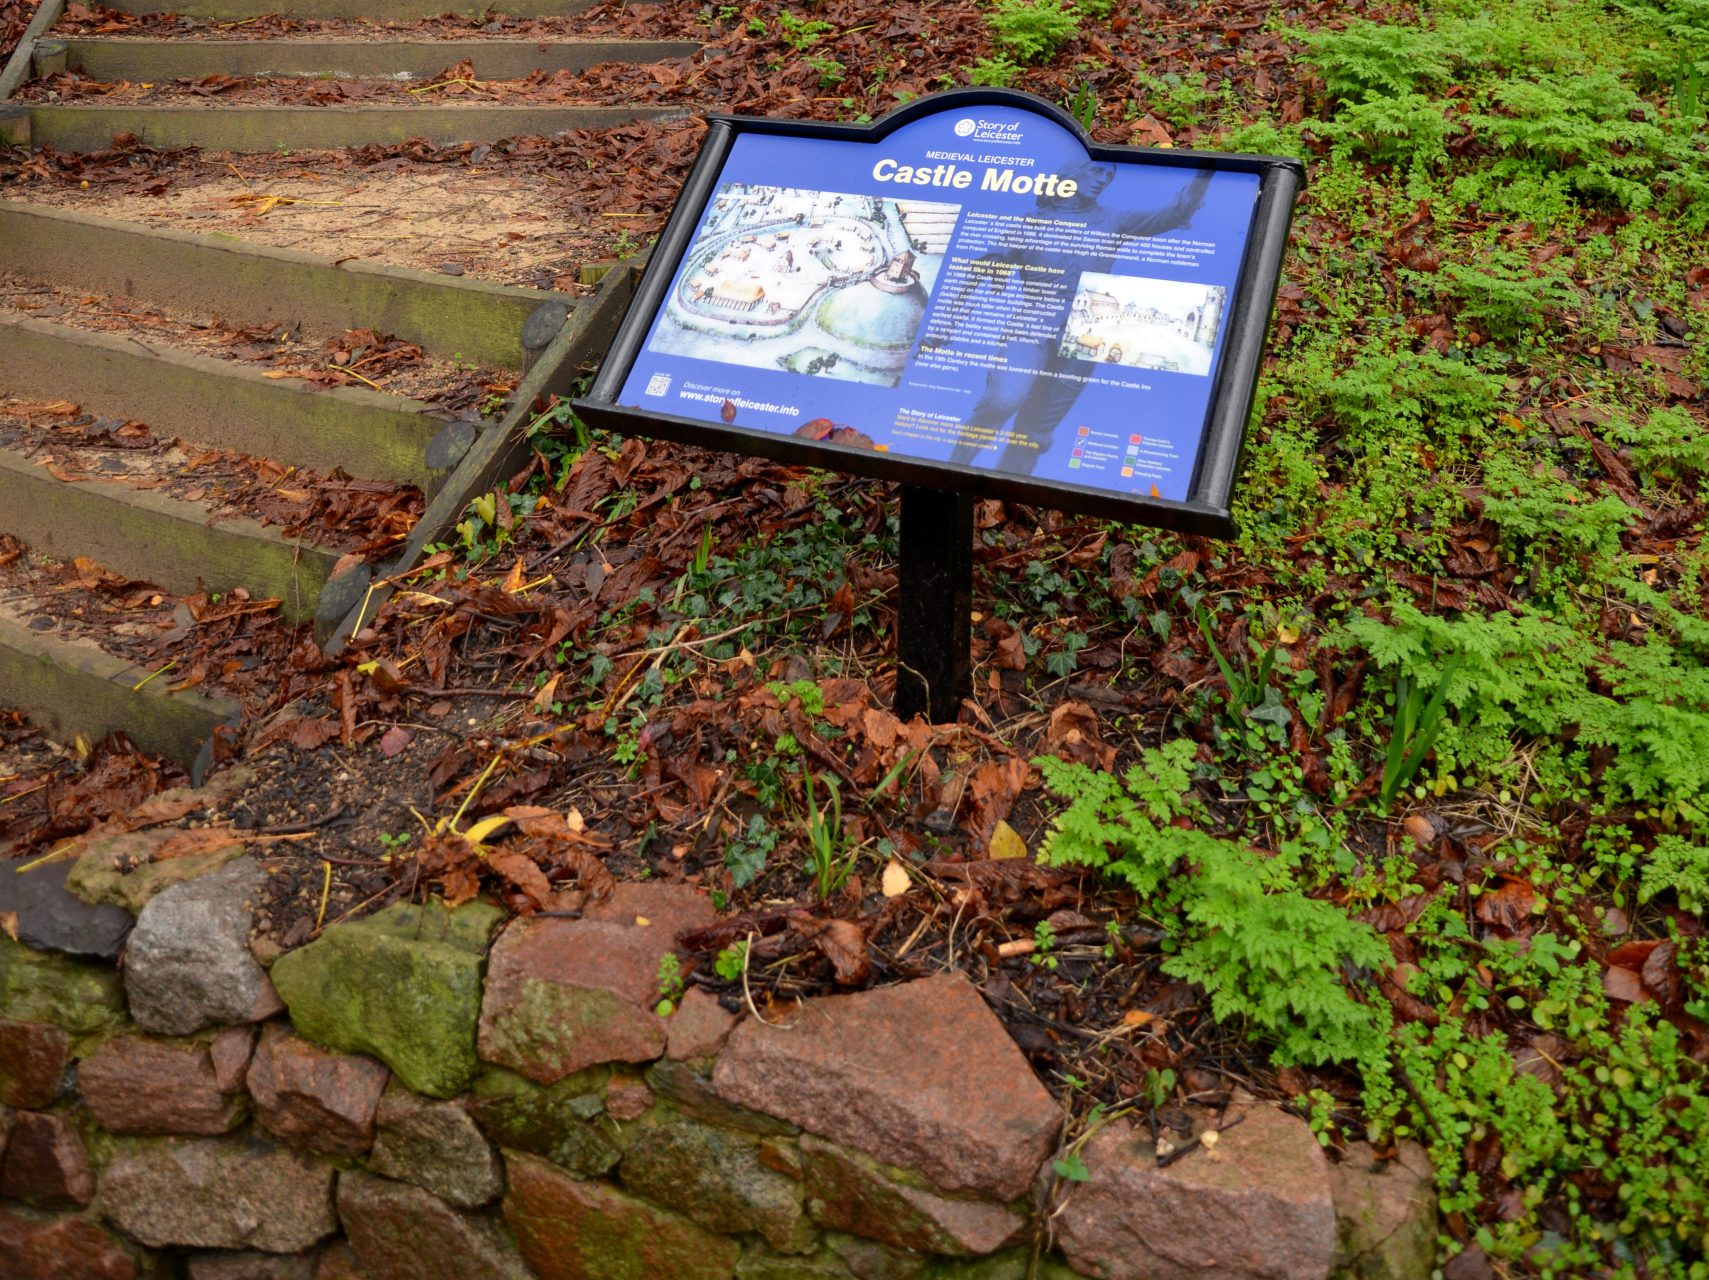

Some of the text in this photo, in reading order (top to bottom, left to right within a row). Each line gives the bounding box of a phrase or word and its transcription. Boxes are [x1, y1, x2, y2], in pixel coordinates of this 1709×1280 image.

[977, 120, 1020, 132] Story of
[974, 128, 1023, 140] Leicester
[925, 150, 1034, 166] MEDIEVAL LEICESTER
[873, 158, 1076, 197] Castle Motte
[966, 211, 997, 219] Leicester
[1053, 219, 1086, 228] Conquest
[948, 263, 972, 271] looked
[991, 261, 1023, 270] Leicester
[934, 347, 954, 355] Motte
[988, 354, 1008, 363] times
[683, 381, 712, 391] Discover
[910, 409, 926, 418] Story
[933, 413, 960, 422] Leicester
